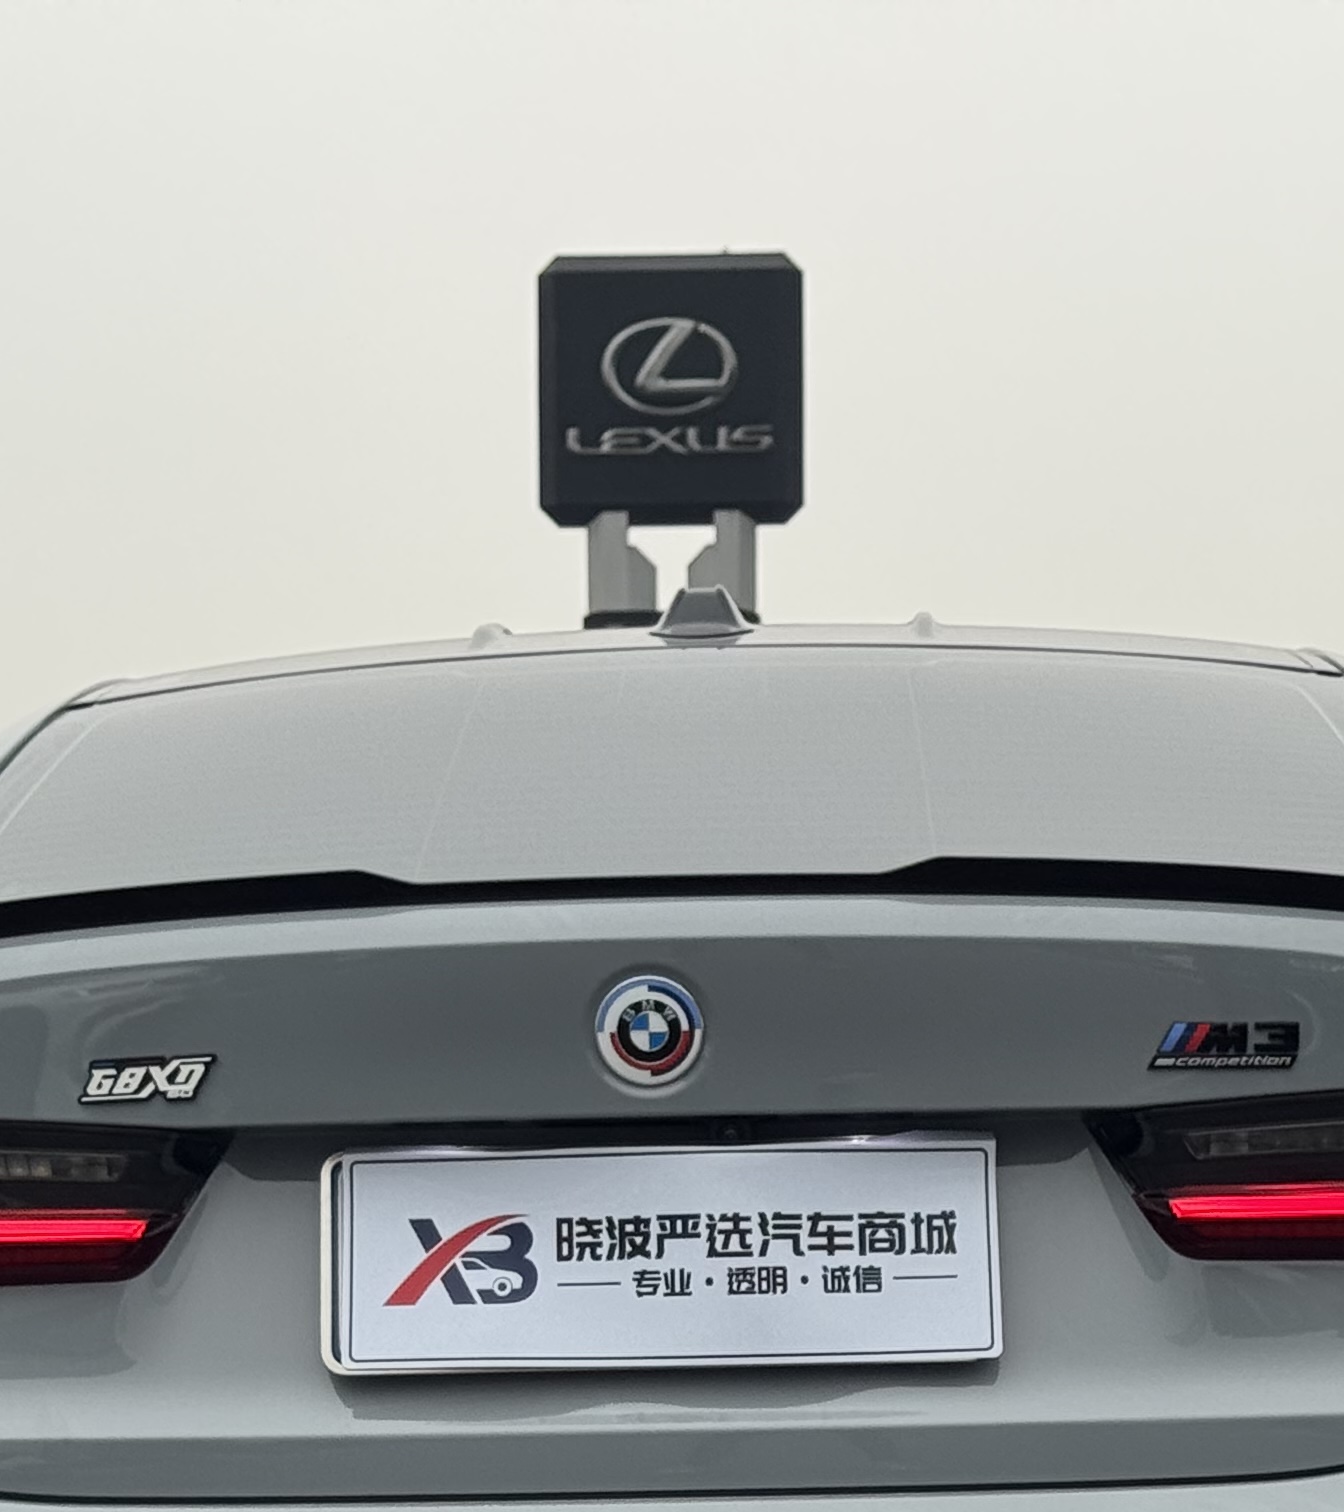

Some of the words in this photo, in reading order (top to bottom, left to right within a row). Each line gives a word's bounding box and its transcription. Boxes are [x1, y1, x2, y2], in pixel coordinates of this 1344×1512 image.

[565, 423, 775, 456] LEXUS
[622, 1000, 677, 1022] BMW
[555, 1210, 957, 1262] 晓波严选汽车商城
